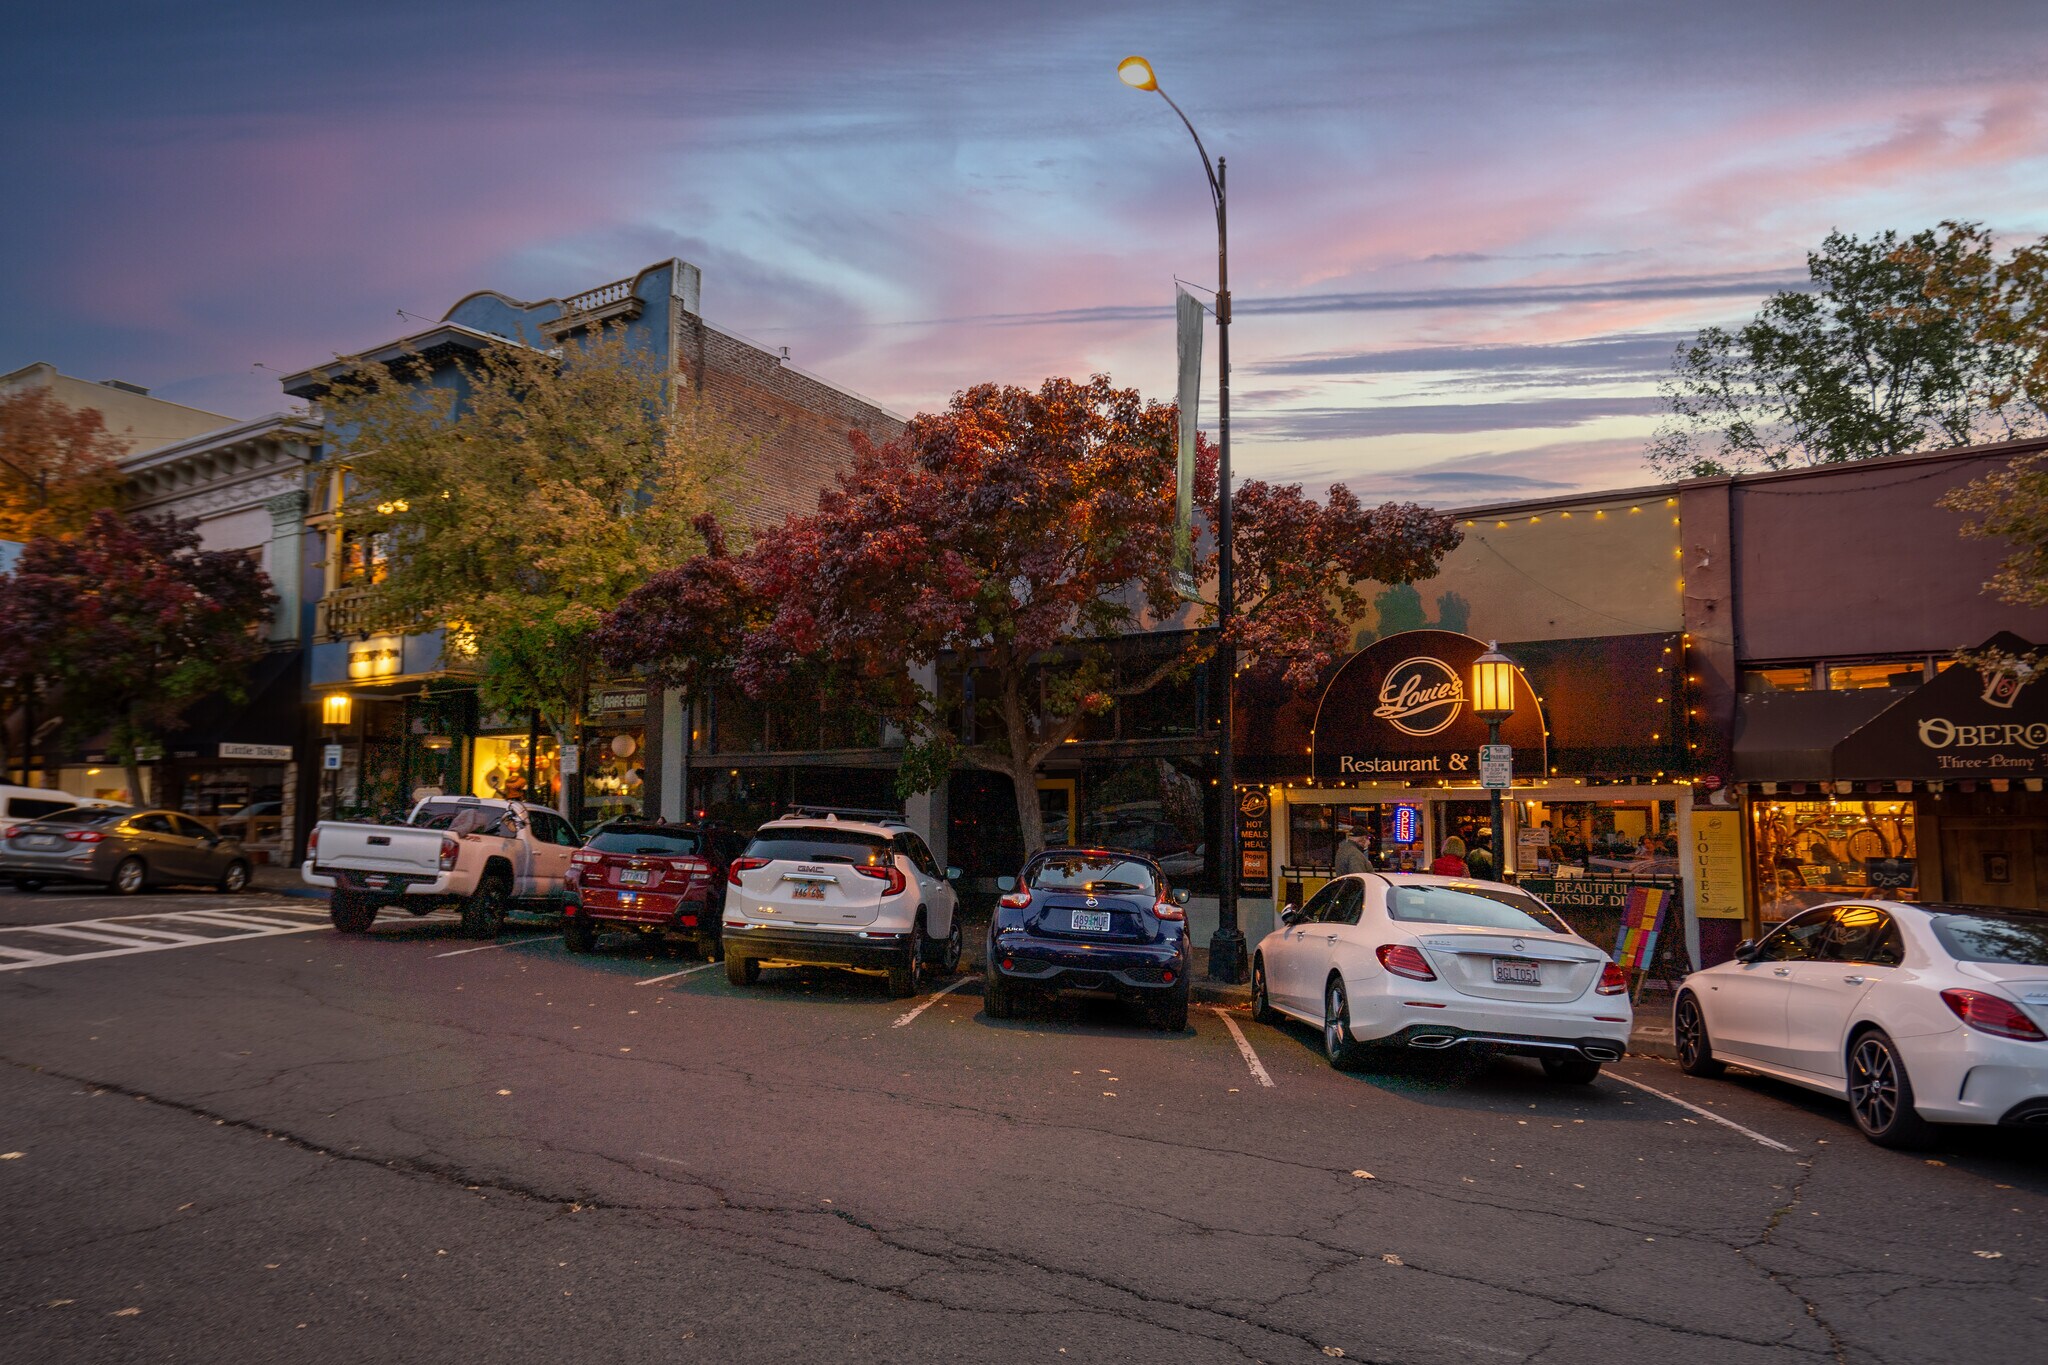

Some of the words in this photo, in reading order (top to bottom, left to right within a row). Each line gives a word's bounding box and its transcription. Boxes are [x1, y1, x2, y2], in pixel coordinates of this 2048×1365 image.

[1482, 749, 1490, 760] 2
[1340, 755, 1440, 773] Restaurant
[1449, 753, 1469, 771] &
[1937, 754, 2035, 771] Three-Penny
[1401, 810, 1410, 840] OPEN
[797, 865, 825, 873] GMC
[1697, 830, 1709, 903] LOUIES
[1555, 882, 1628, 895] BEAUTIFUL
[1535, 892, 1605, 906] REEKSIDE
[1074, 914, 1089, 927] 489
[1093, 916, 1108, 927] MUF
[1497, 967, 1539, 982] 8GLT051
